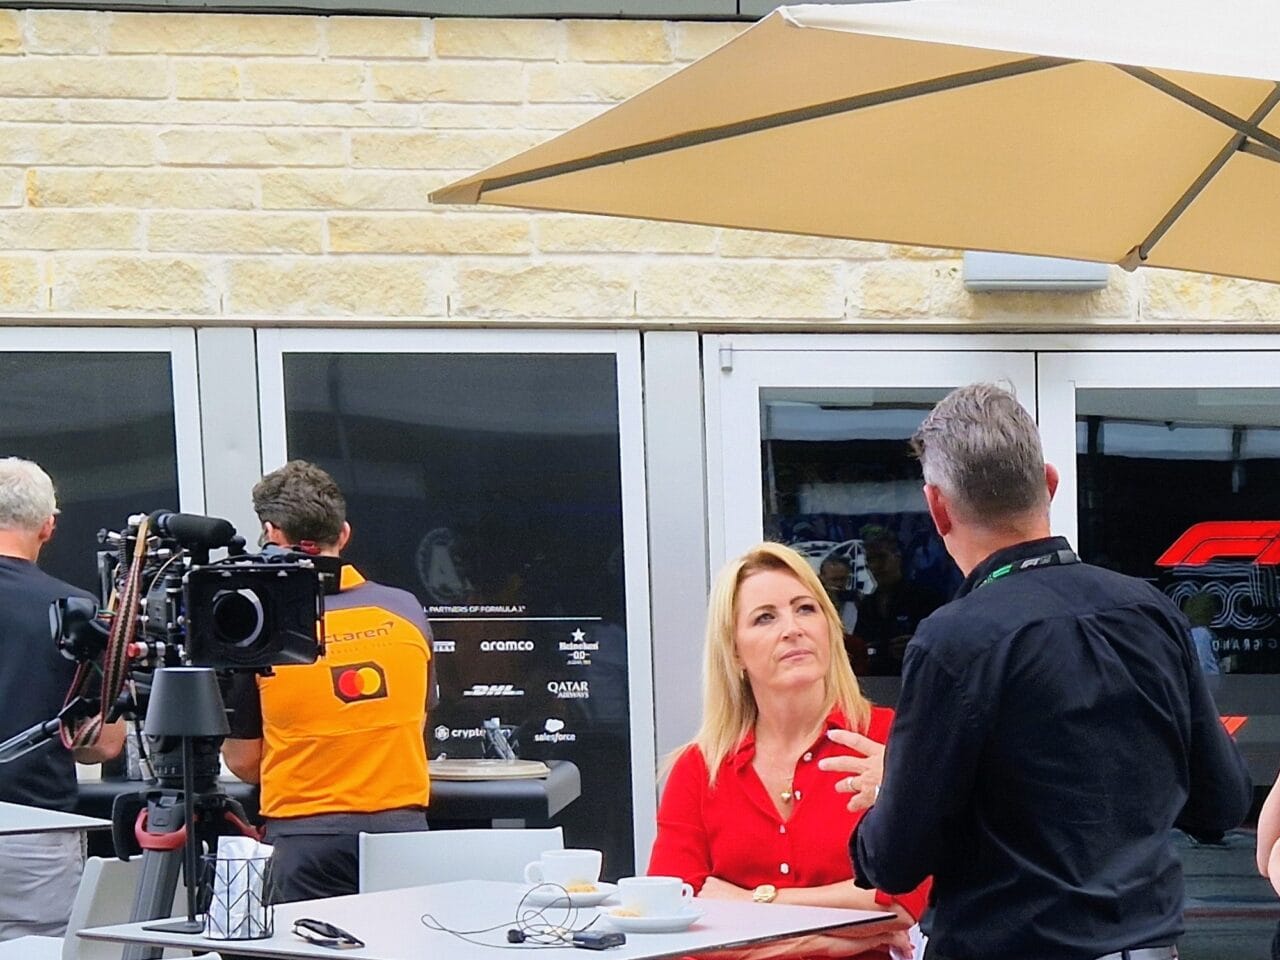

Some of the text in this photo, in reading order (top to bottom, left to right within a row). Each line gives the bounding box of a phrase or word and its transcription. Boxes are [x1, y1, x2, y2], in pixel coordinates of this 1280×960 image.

[480, 640, 535, 651] aramco
[471, 681, 589, 696] DHL QATAR
[534, 733, 576, 743] salesforce
